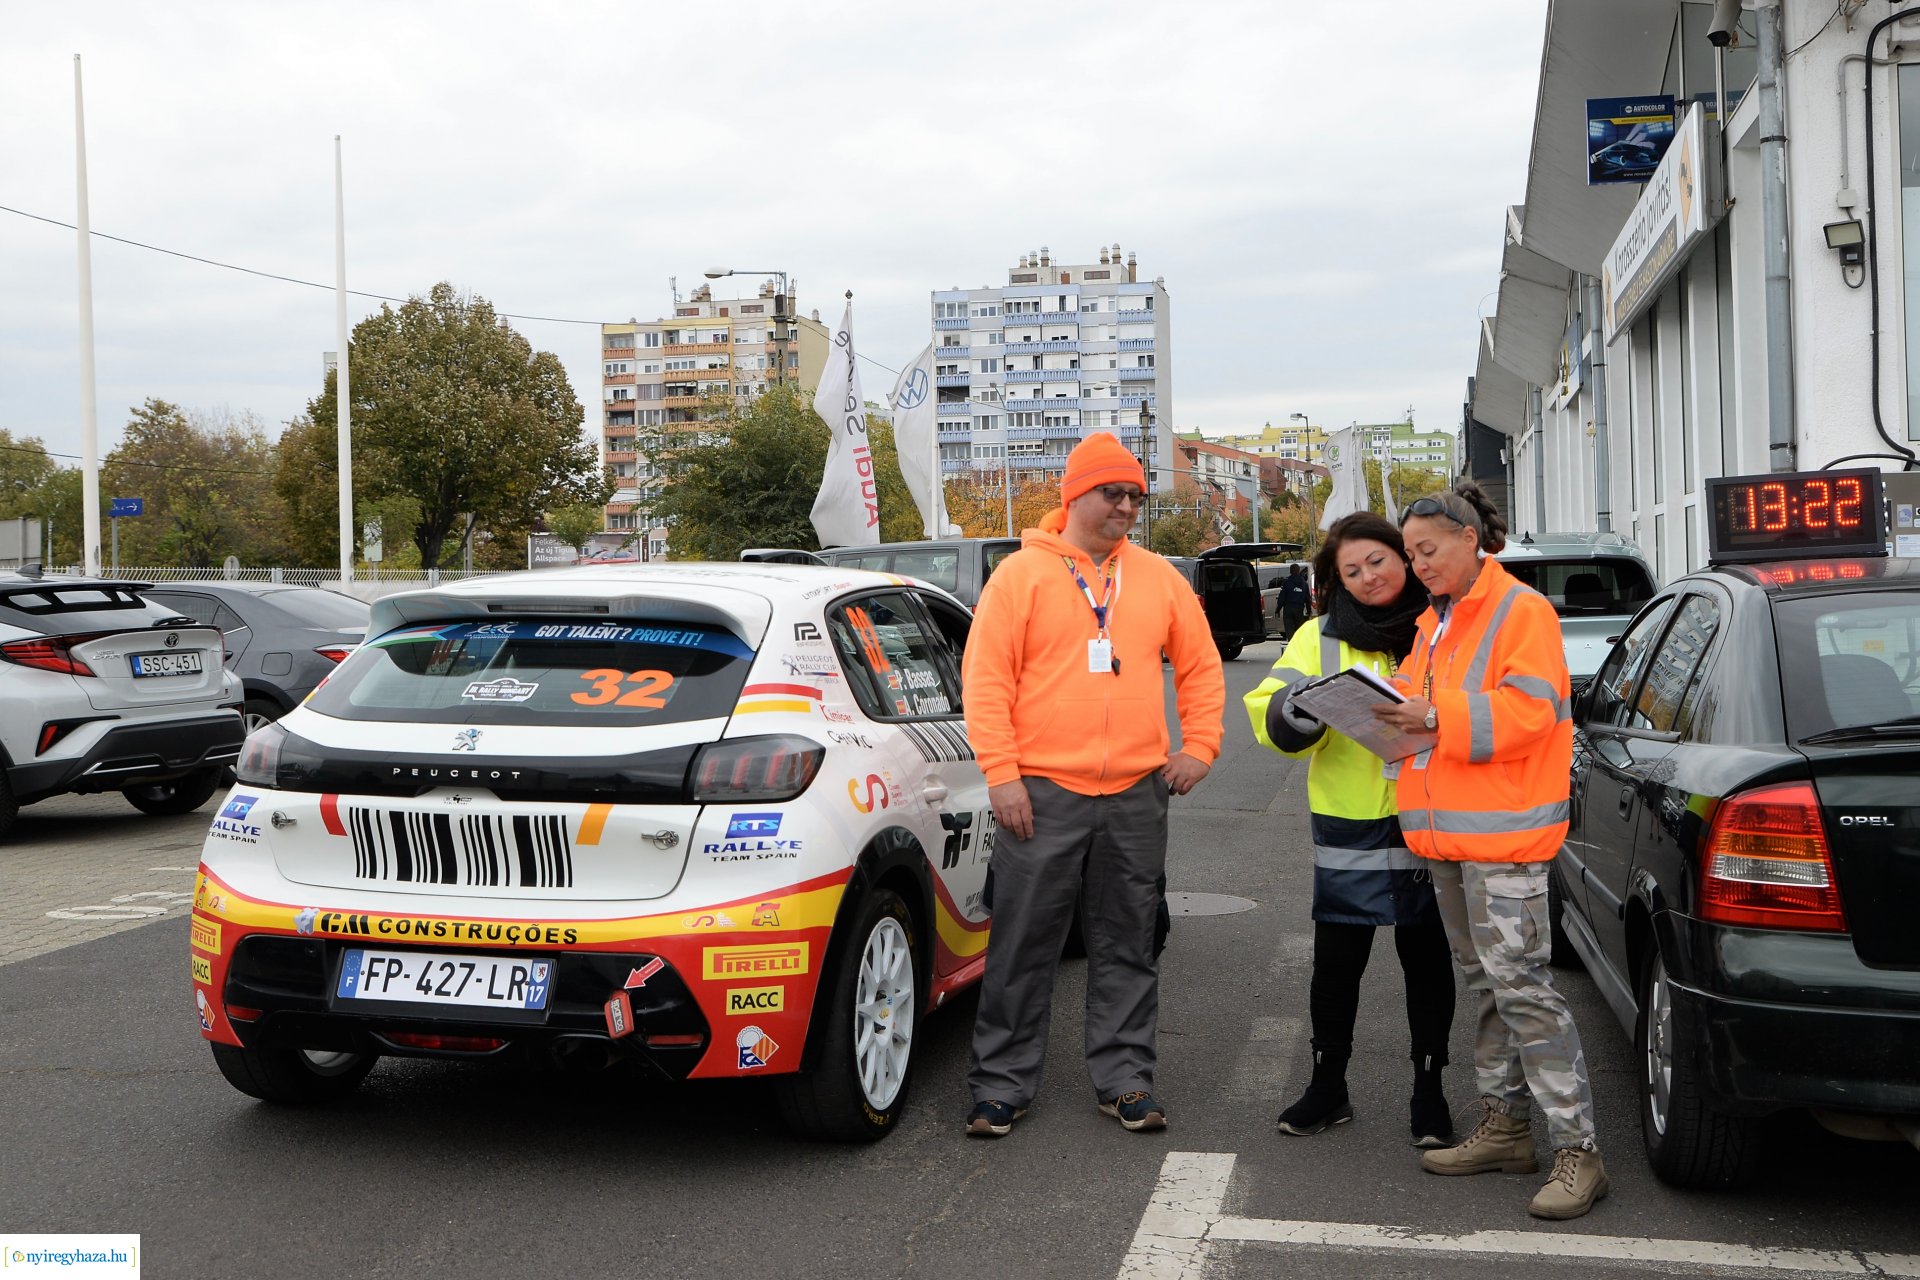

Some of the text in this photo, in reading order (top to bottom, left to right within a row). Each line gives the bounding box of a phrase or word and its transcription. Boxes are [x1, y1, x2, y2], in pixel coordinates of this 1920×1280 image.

[1633, 104, 1666, 112] AUTOCOLOR
[1747, 479, 1861, 529] 13:22
[535, 625, 703, 646] GOT TALENT? PROVE IT!
[143, 654, 197, 673] SSC-451
[795, 655, 833, 663] PEUGEOT
[800, 663, 822, 671] RALLY
[895, 668, 936, 690] P. Bassas
[499, 687, 532, 695] HUNGARY
[570, 668, 675, 709] 32
[903, 692, 951, 716] A. Coronado
[393, 768, 520, 779] PEUGEOT
[226, 802, 252, 813] RTS
[730, 820, 779, 831] RTS
[1840, 816, 1895, 826] OPEL
[230, 835, 257, 844] SPAIN
[704, 841, 802, 853] RALLYE
[378, 918, 577, 946] CONSTRUÇÕES
[193, 960, 209, 980] RACC
[713, 949, 801, 974] PIRELLI
[345, 957, 544, 1003] F FP-427-LR 17
[731, 992, 778, 1010] RACC
[611, 999, 624, 1032] sparco
